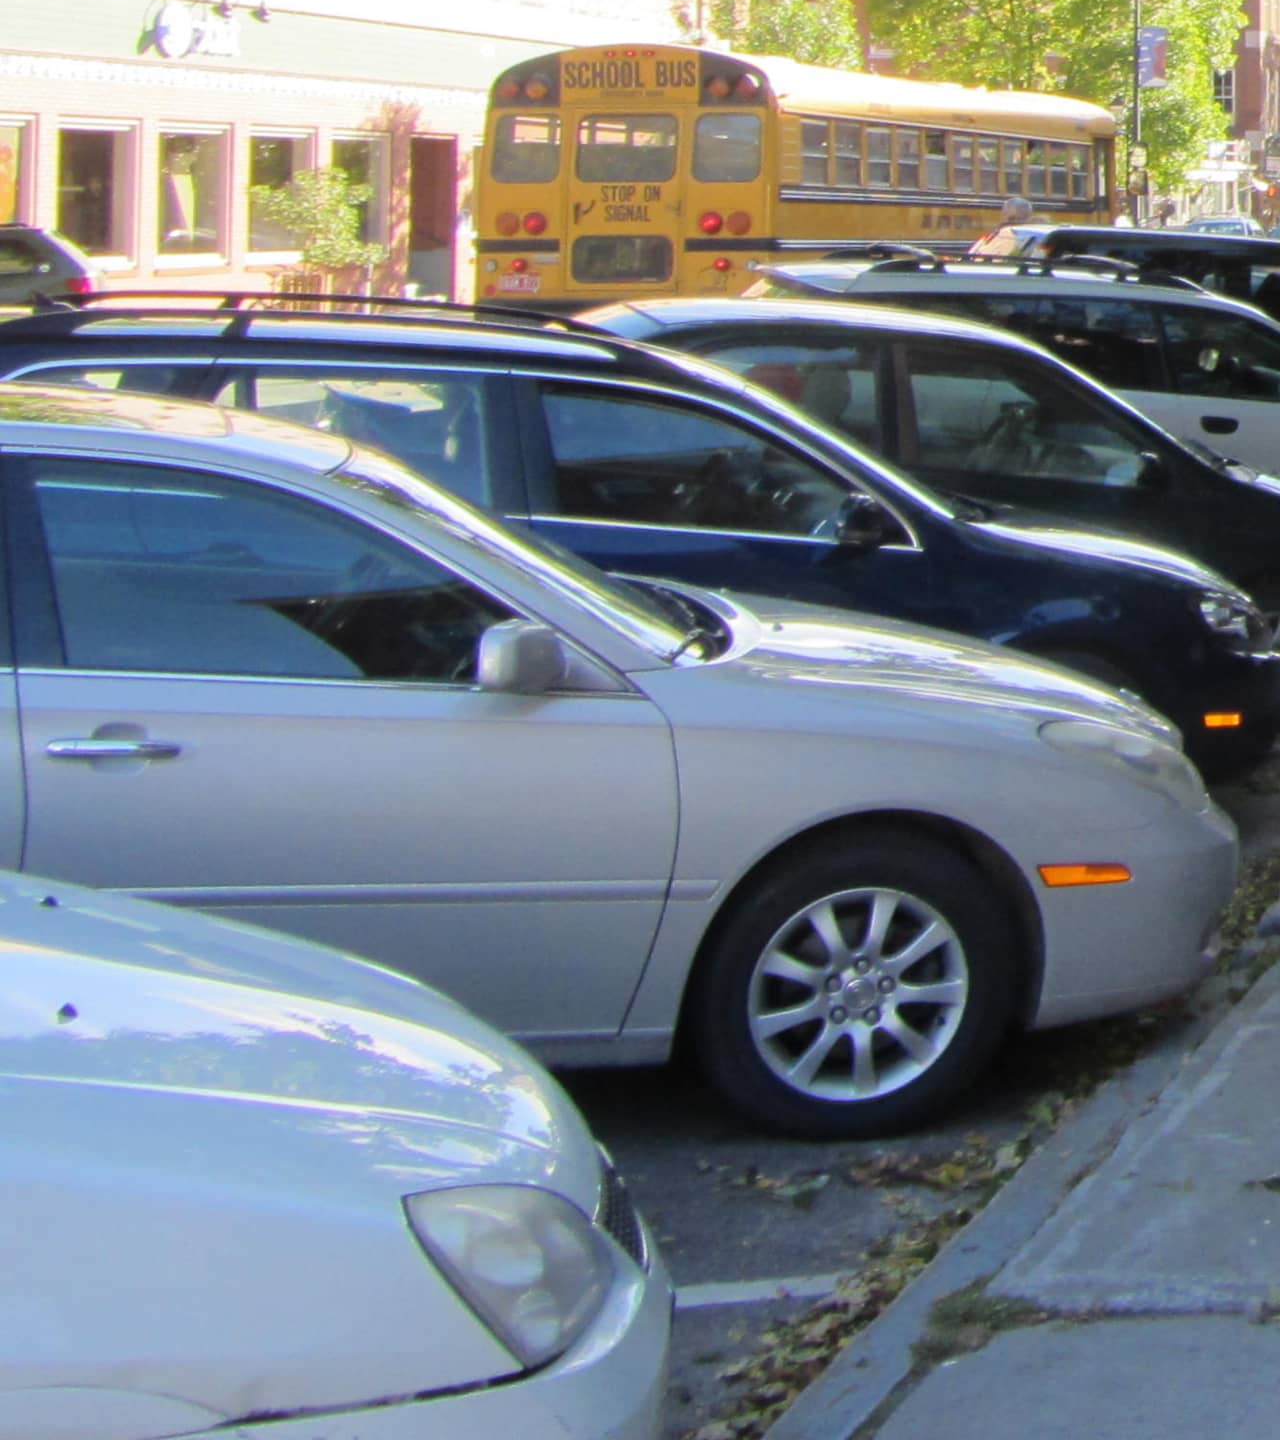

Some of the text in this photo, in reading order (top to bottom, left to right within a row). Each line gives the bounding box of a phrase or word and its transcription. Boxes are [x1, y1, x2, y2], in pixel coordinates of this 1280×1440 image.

[564, 60, 697, 89] SCHOOL BUS
[601, 184, 661, 202] STOP ON
[604, 206, 651, 222] SIGNAL
